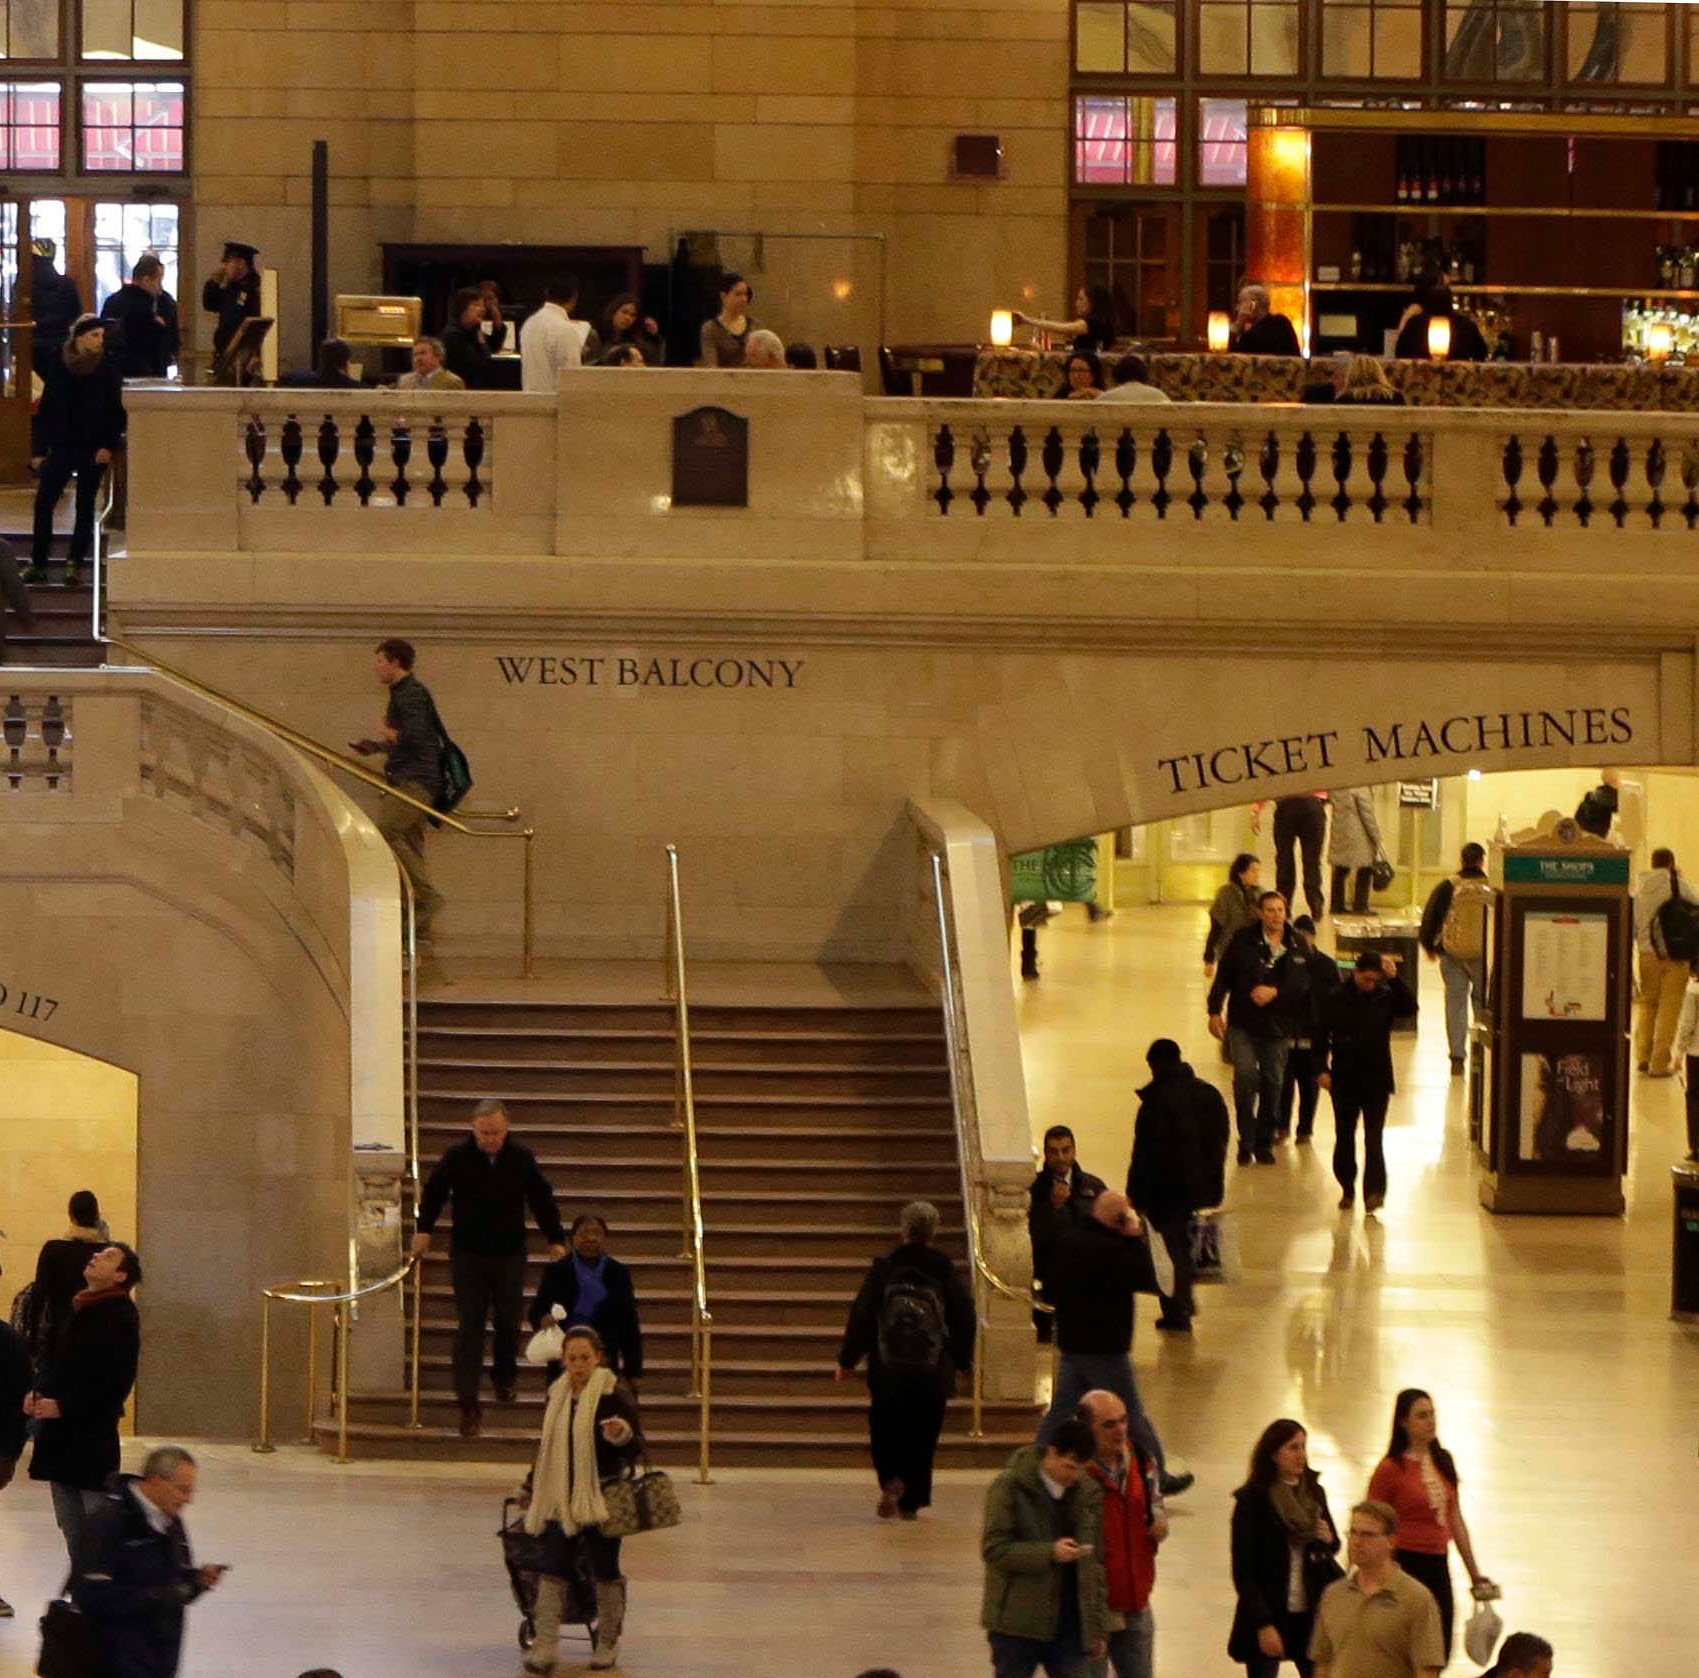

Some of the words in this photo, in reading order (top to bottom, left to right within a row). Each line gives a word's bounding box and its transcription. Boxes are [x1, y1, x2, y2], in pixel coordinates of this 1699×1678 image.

[495, 656, 604, 686] WEST
[617, 657, 805, 688] BALCONY
[1158, 731, 1339, 794] TICKET
[1363, 706, 1633, 765] MACHINES
[15, 991, 59, 1022] 117
